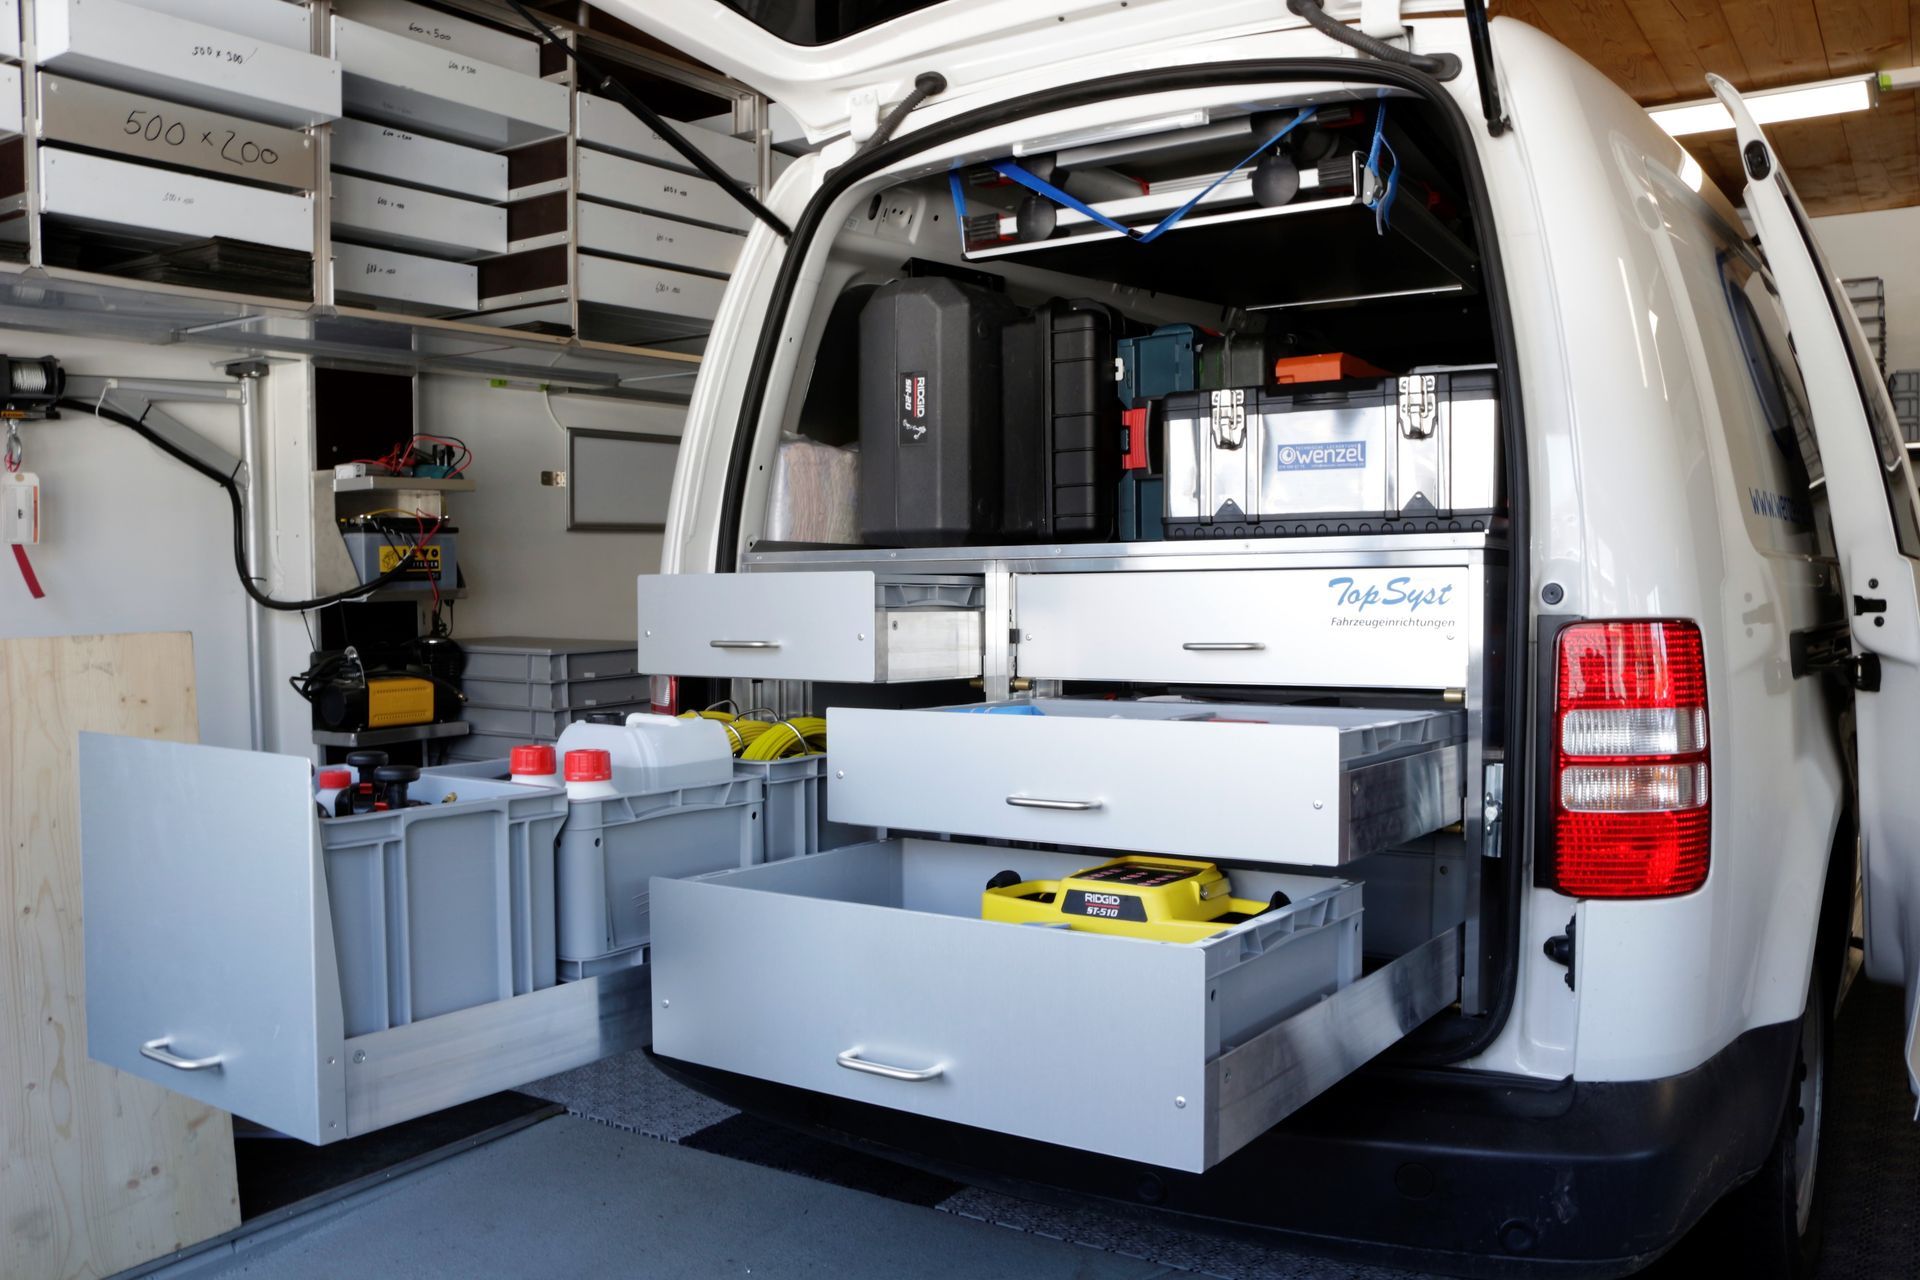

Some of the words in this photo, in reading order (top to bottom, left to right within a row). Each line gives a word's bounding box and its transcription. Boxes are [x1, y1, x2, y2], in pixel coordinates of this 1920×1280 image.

[433, 28, 452, 41] 500
[124, 110, 186, 146] 500
[200, 131, 215, 146] x
[220, 130, 279, 165] 200
[904, 378, 912, 411] SR-20
[917, 376, 926, 418] RIDGID
[1295, 443, 1364, 465] wenzel
[1330, 617, 1456, 629] Fahrzeugeinrichtungen
[1084, 892, 1120, 905] RIDGID
[1086, 906, 1119, 917] ST-510
